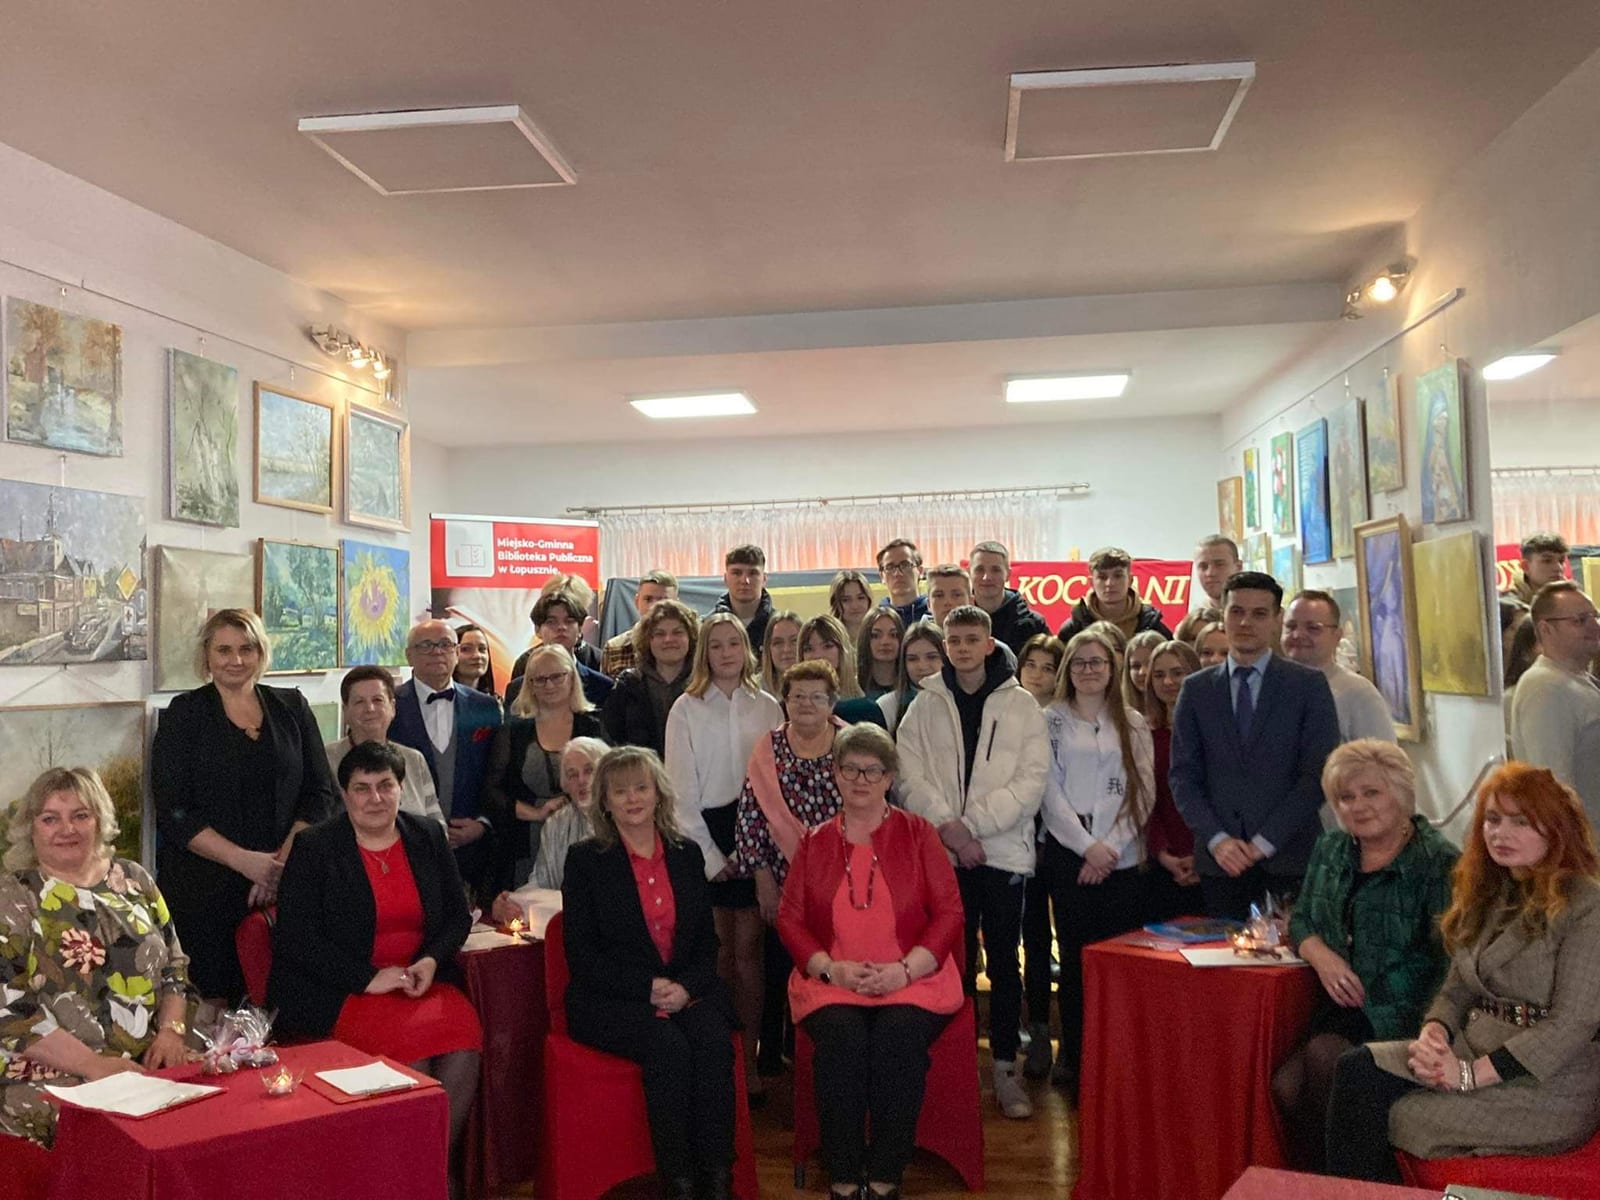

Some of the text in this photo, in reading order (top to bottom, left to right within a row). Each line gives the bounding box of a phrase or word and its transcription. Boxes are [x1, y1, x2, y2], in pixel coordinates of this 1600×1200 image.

[497, 537, 574, 549] Miejsko-Gminna
[498, 551, 594, 563] Biblioteka Publiczna
[498, 566, 507, 574] w
